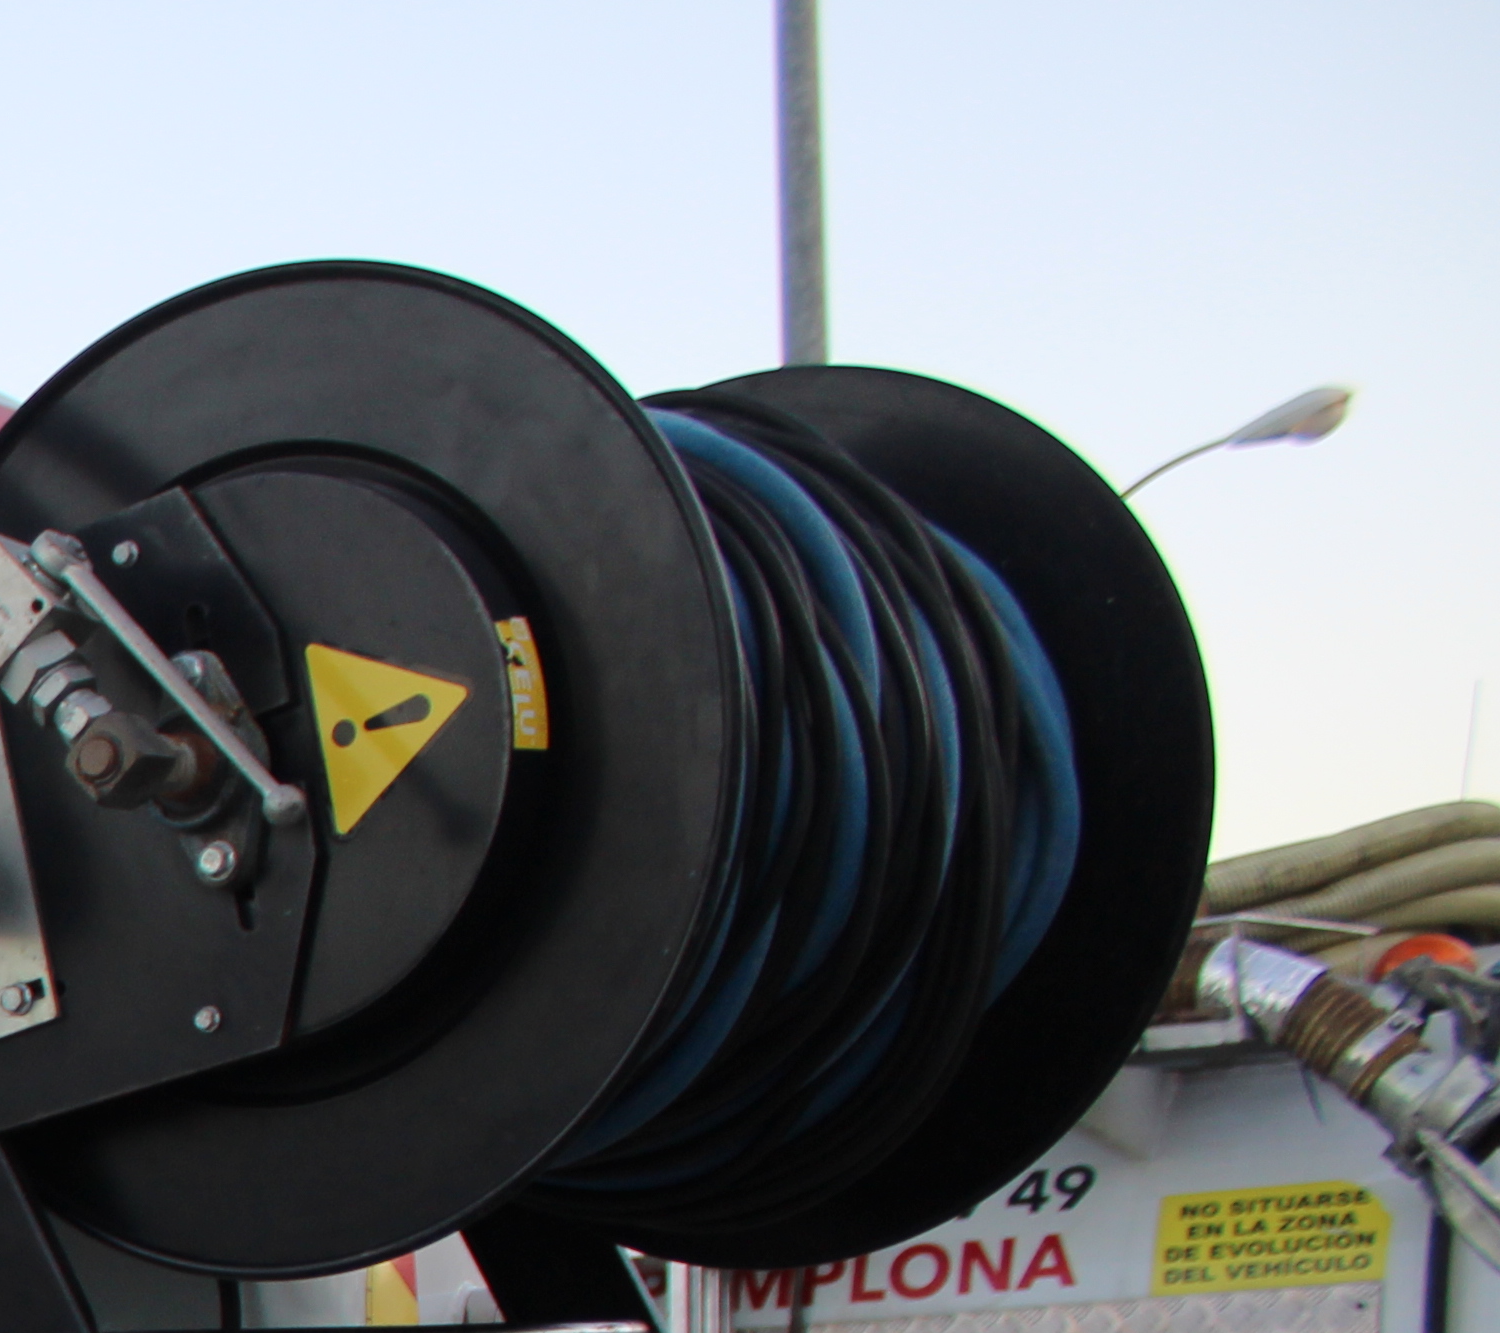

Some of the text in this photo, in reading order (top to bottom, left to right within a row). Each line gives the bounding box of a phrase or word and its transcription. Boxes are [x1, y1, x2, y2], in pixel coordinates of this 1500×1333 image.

[1007, 1163, 1097, 1215] 49
[1180, 1188, 1371, 1220] NO SITUARSE
[1187, 1211, 1357, 1240] EN LA ZONA
[1164, 1246, 1199, 1263] DE
[1164, 1253, 1372, 1285] DEL VEHÍCULO
[632, 1233, 1075, 1311] MPLONA
